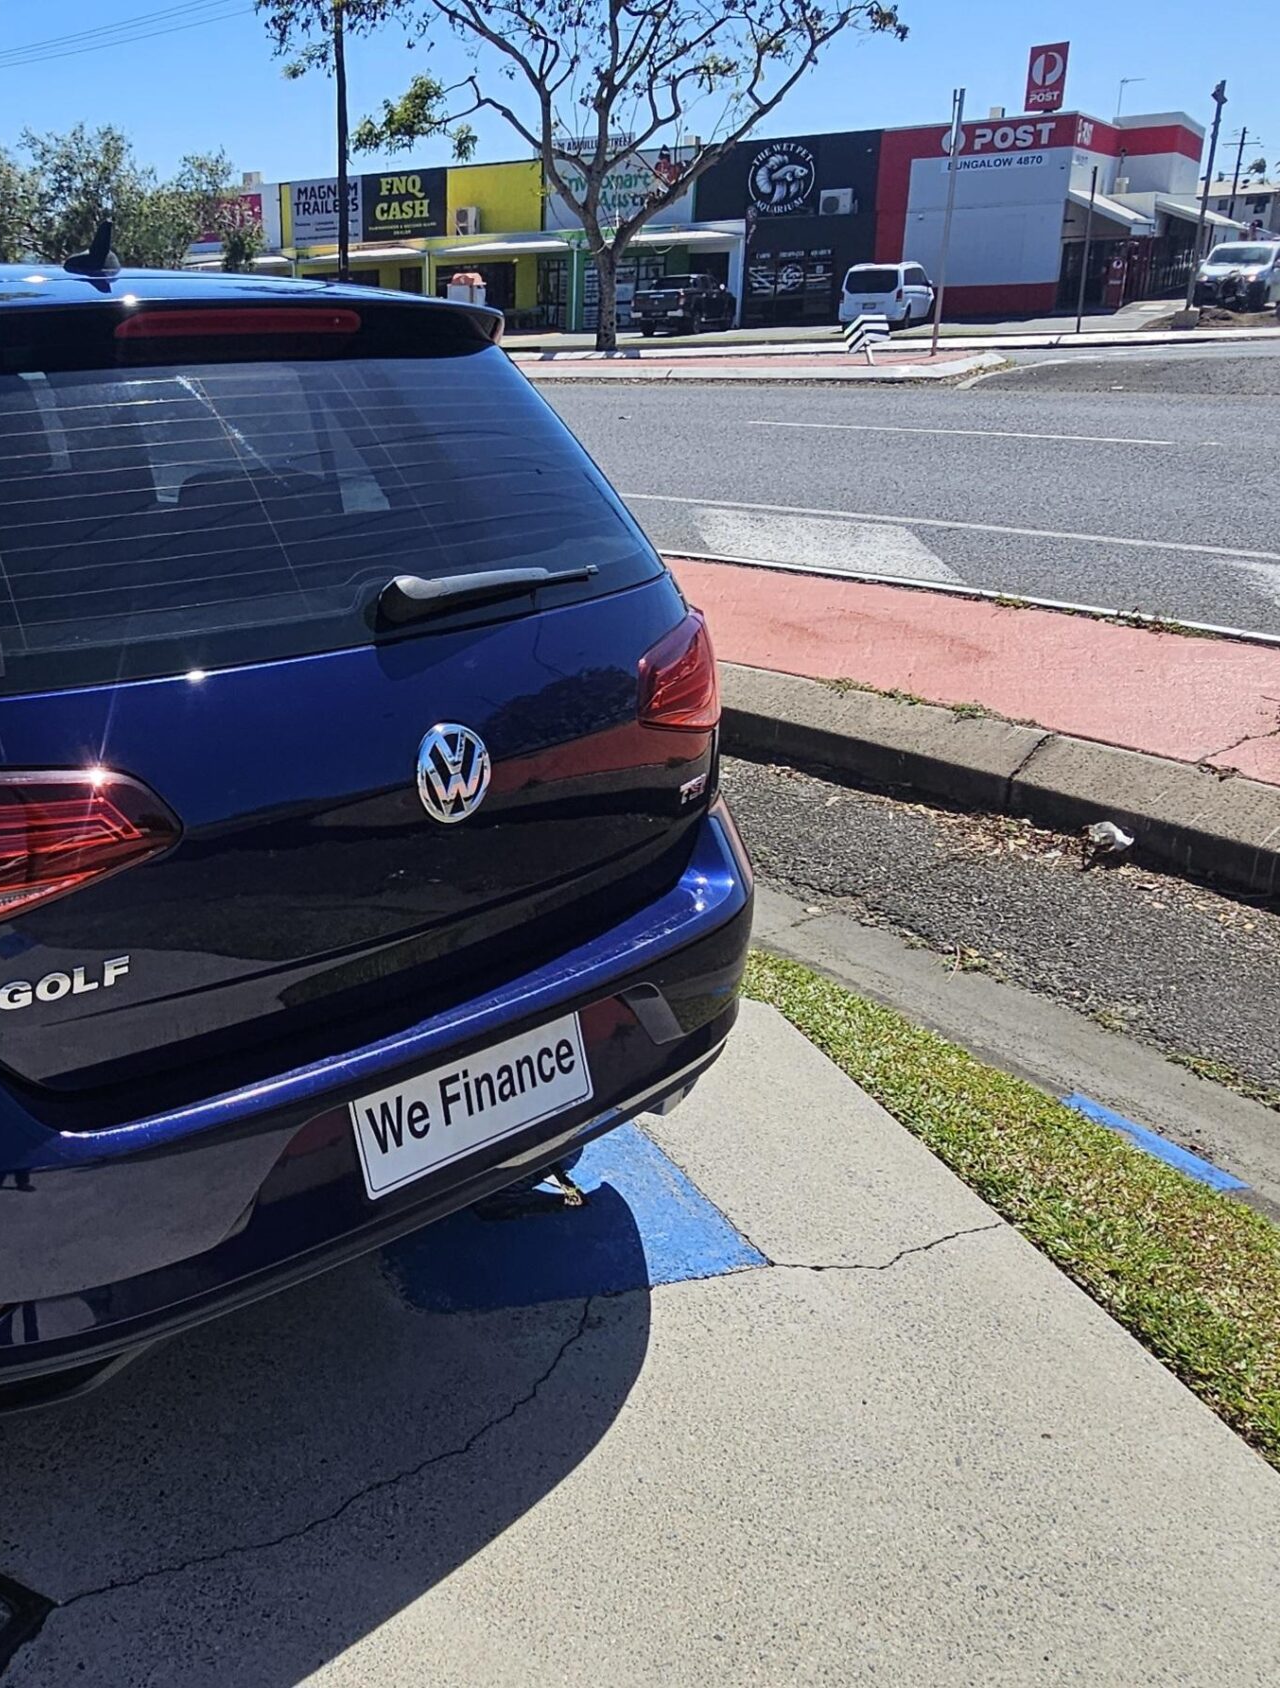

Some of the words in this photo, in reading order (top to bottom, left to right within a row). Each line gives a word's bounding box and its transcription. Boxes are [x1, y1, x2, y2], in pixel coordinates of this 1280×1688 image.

[1029, 91, 1060, 104] POST
[974, 122, 1056, 151] POST
[752, 147, 772, 166] THE
[772, 143, 795, 152] WET
[795, 145, 813, 162] PET
[1016, 155, 1043, 166] 4870
[297, 182, 358, 201] MAGNM
[379, 175, 425, 198] FNQ
[294, 197, 359, 216] TRAILES
[375, 199, 430, 221] CASH
[754, 197, 804, 213] AQUARIUM
[365, 1095, 430, 1155] We
[438, 1038, 576, 1127] Finance
